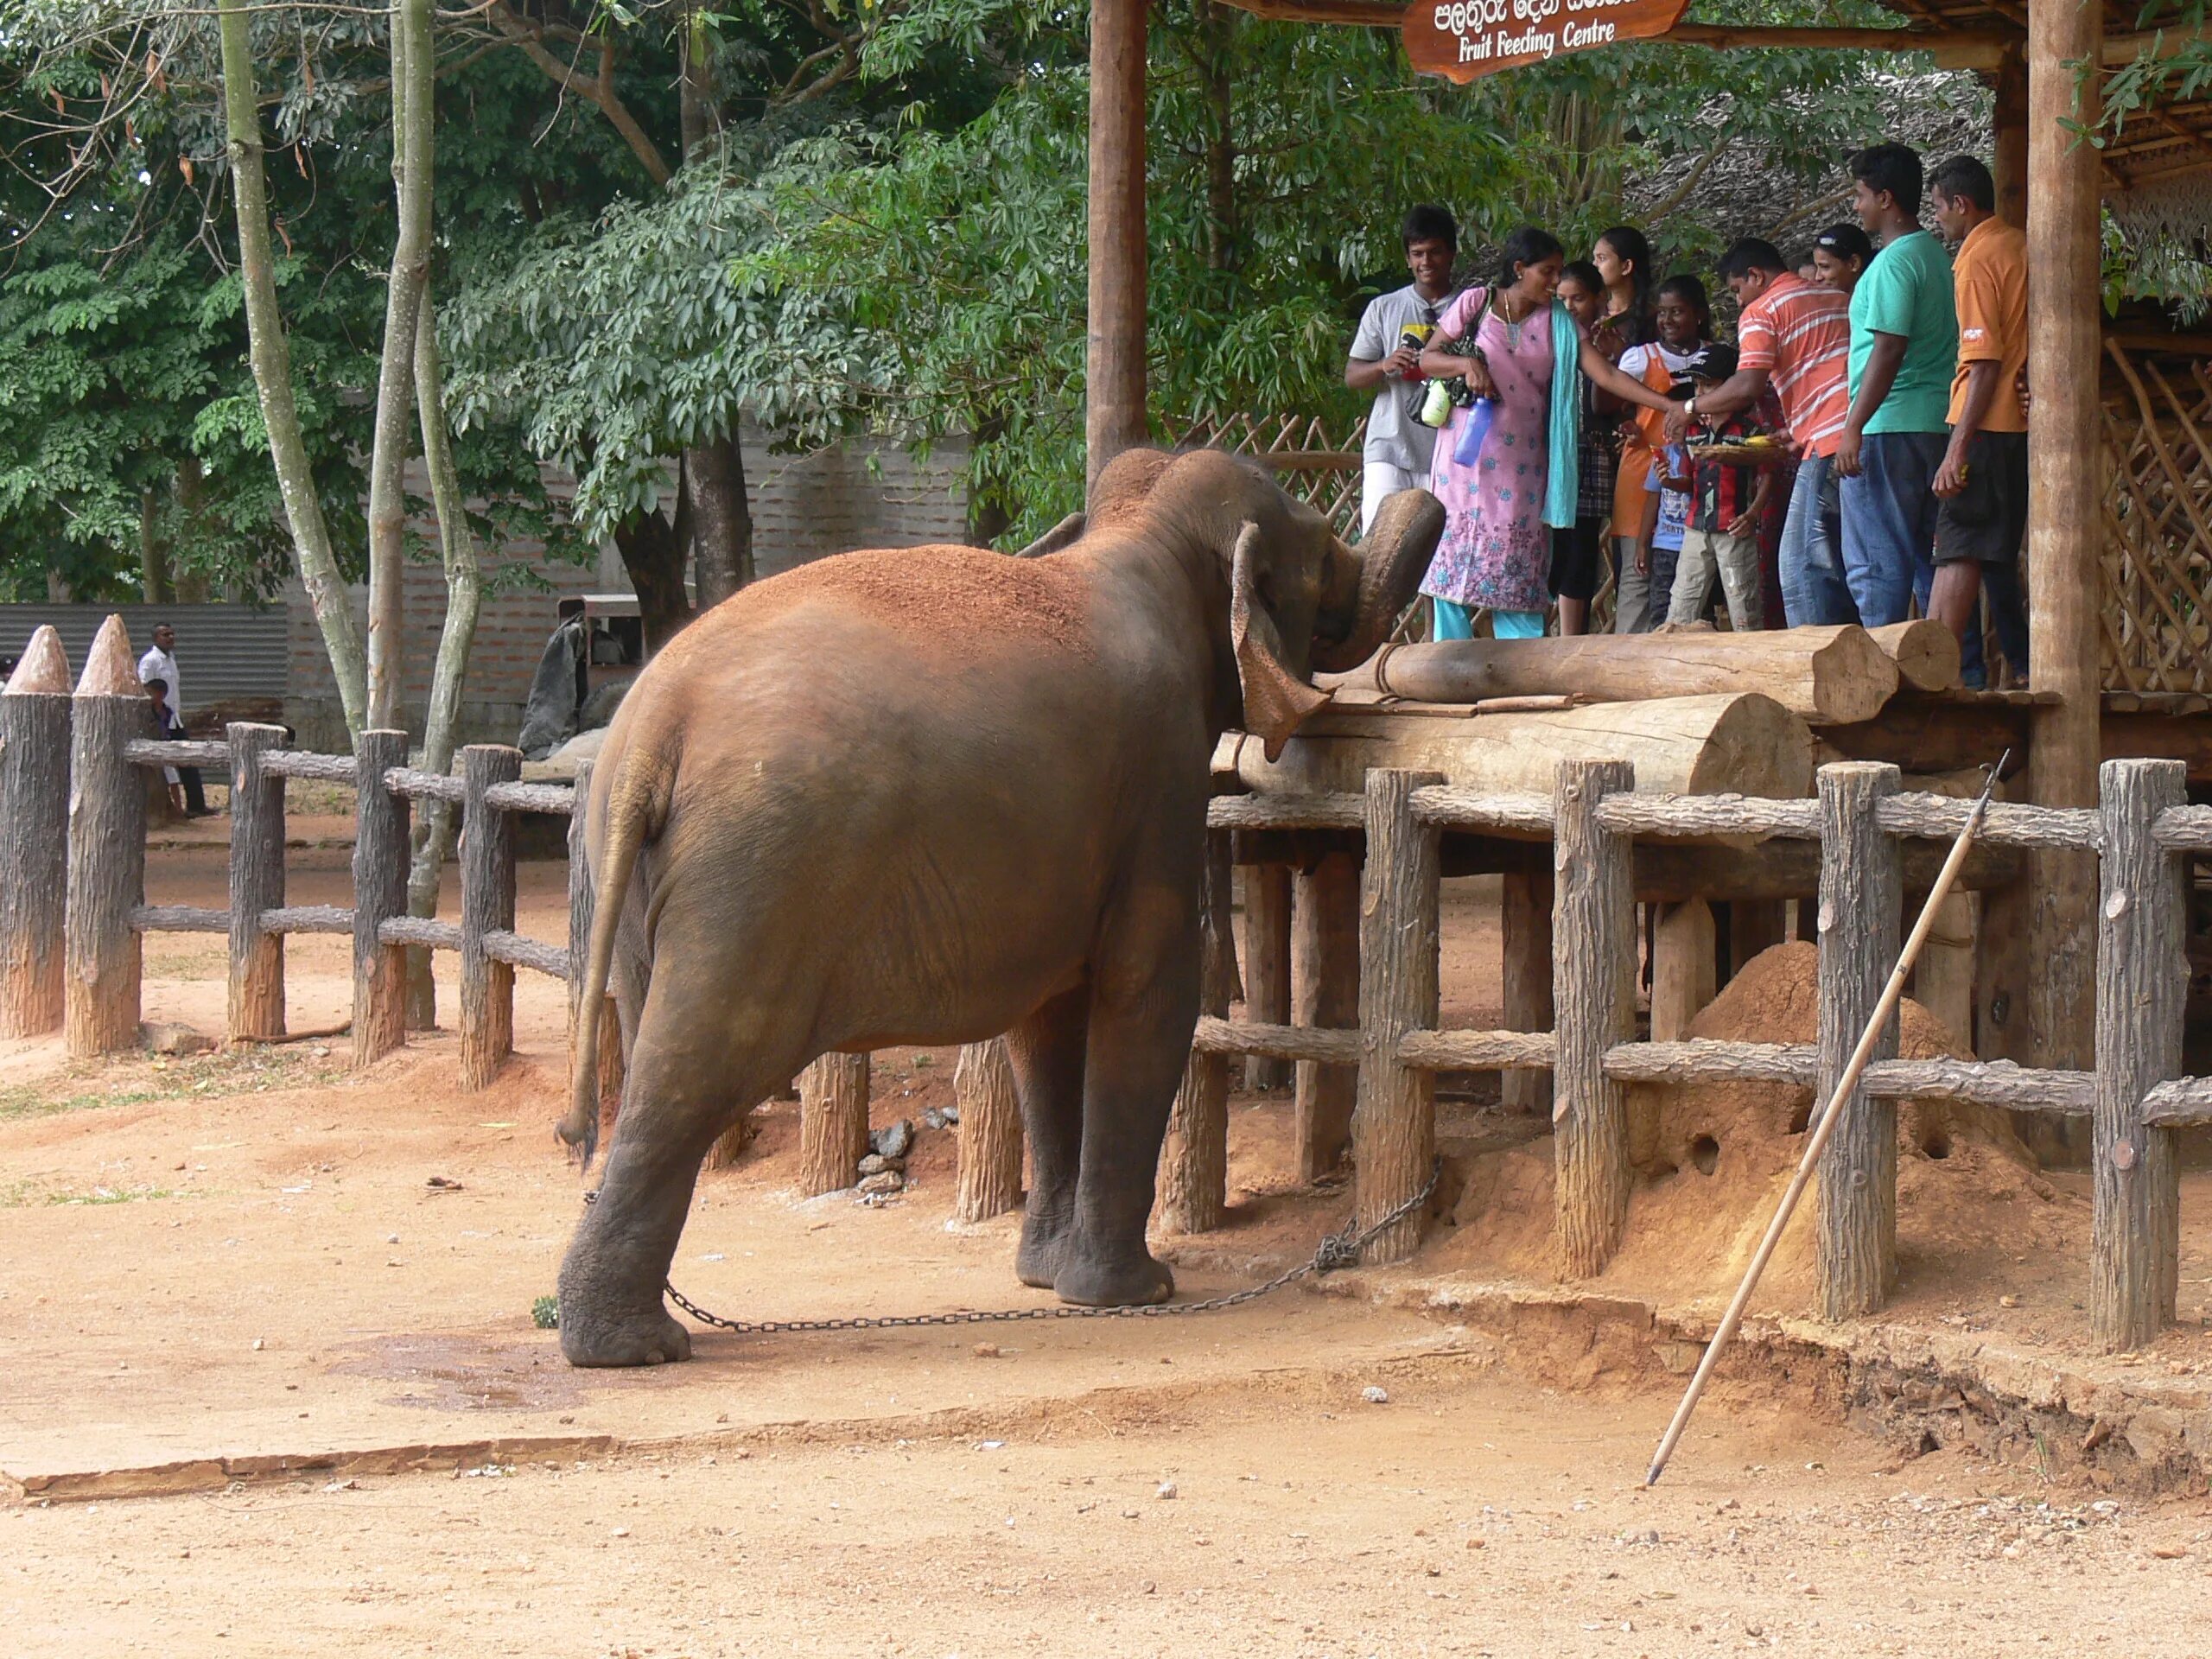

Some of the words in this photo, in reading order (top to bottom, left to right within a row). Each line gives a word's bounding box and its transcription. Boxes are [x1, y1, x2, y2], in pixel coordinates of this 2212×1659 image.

[1459, 33, 1493, 62] Fruit
[1497, 27, 1554, 59] Feeding
[1562, 18, 1614, 48] Centre
